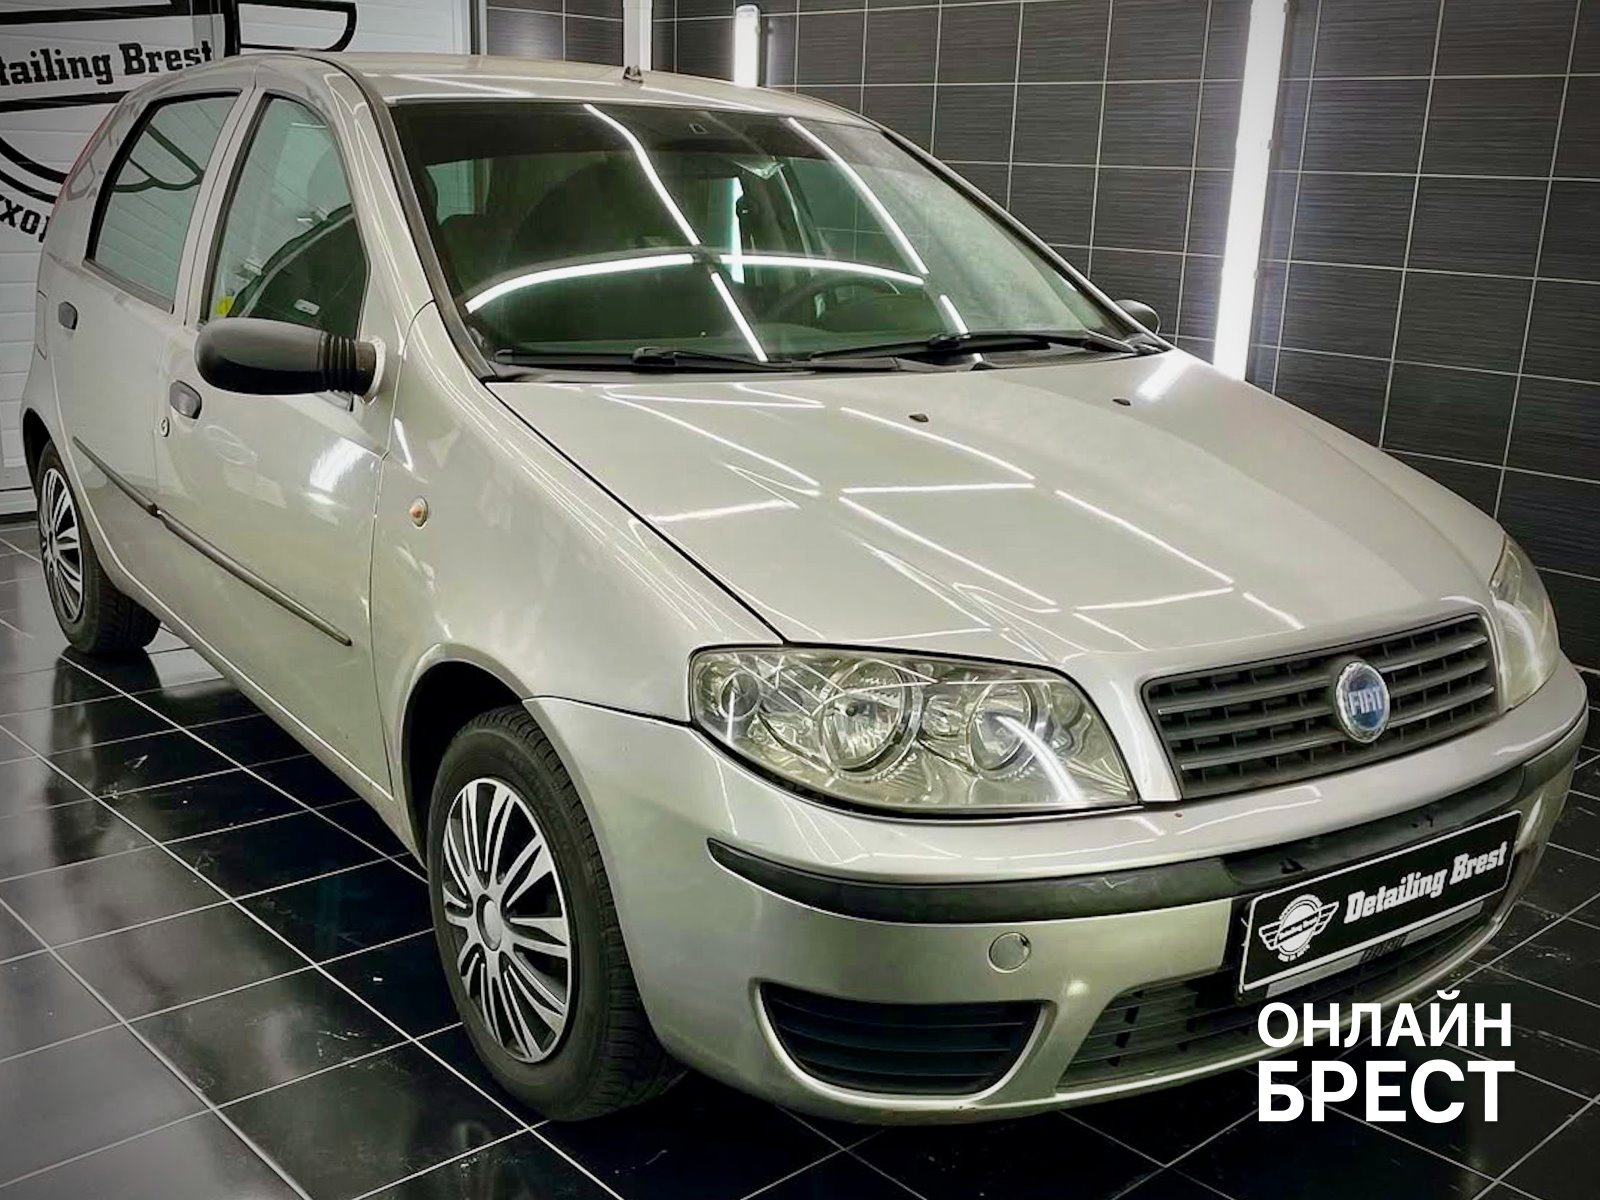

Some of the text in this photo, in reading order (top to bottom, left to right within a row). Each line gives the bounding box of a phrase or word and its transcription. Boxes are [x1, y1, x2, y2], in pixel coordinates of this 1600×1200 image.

[119, 40, 212, 75] Brest
[1348, 685, 1383, 716] FIAT
[1344, 868, 1448, 924] Detailing
[1450, 841, 1508, 885] Brest
